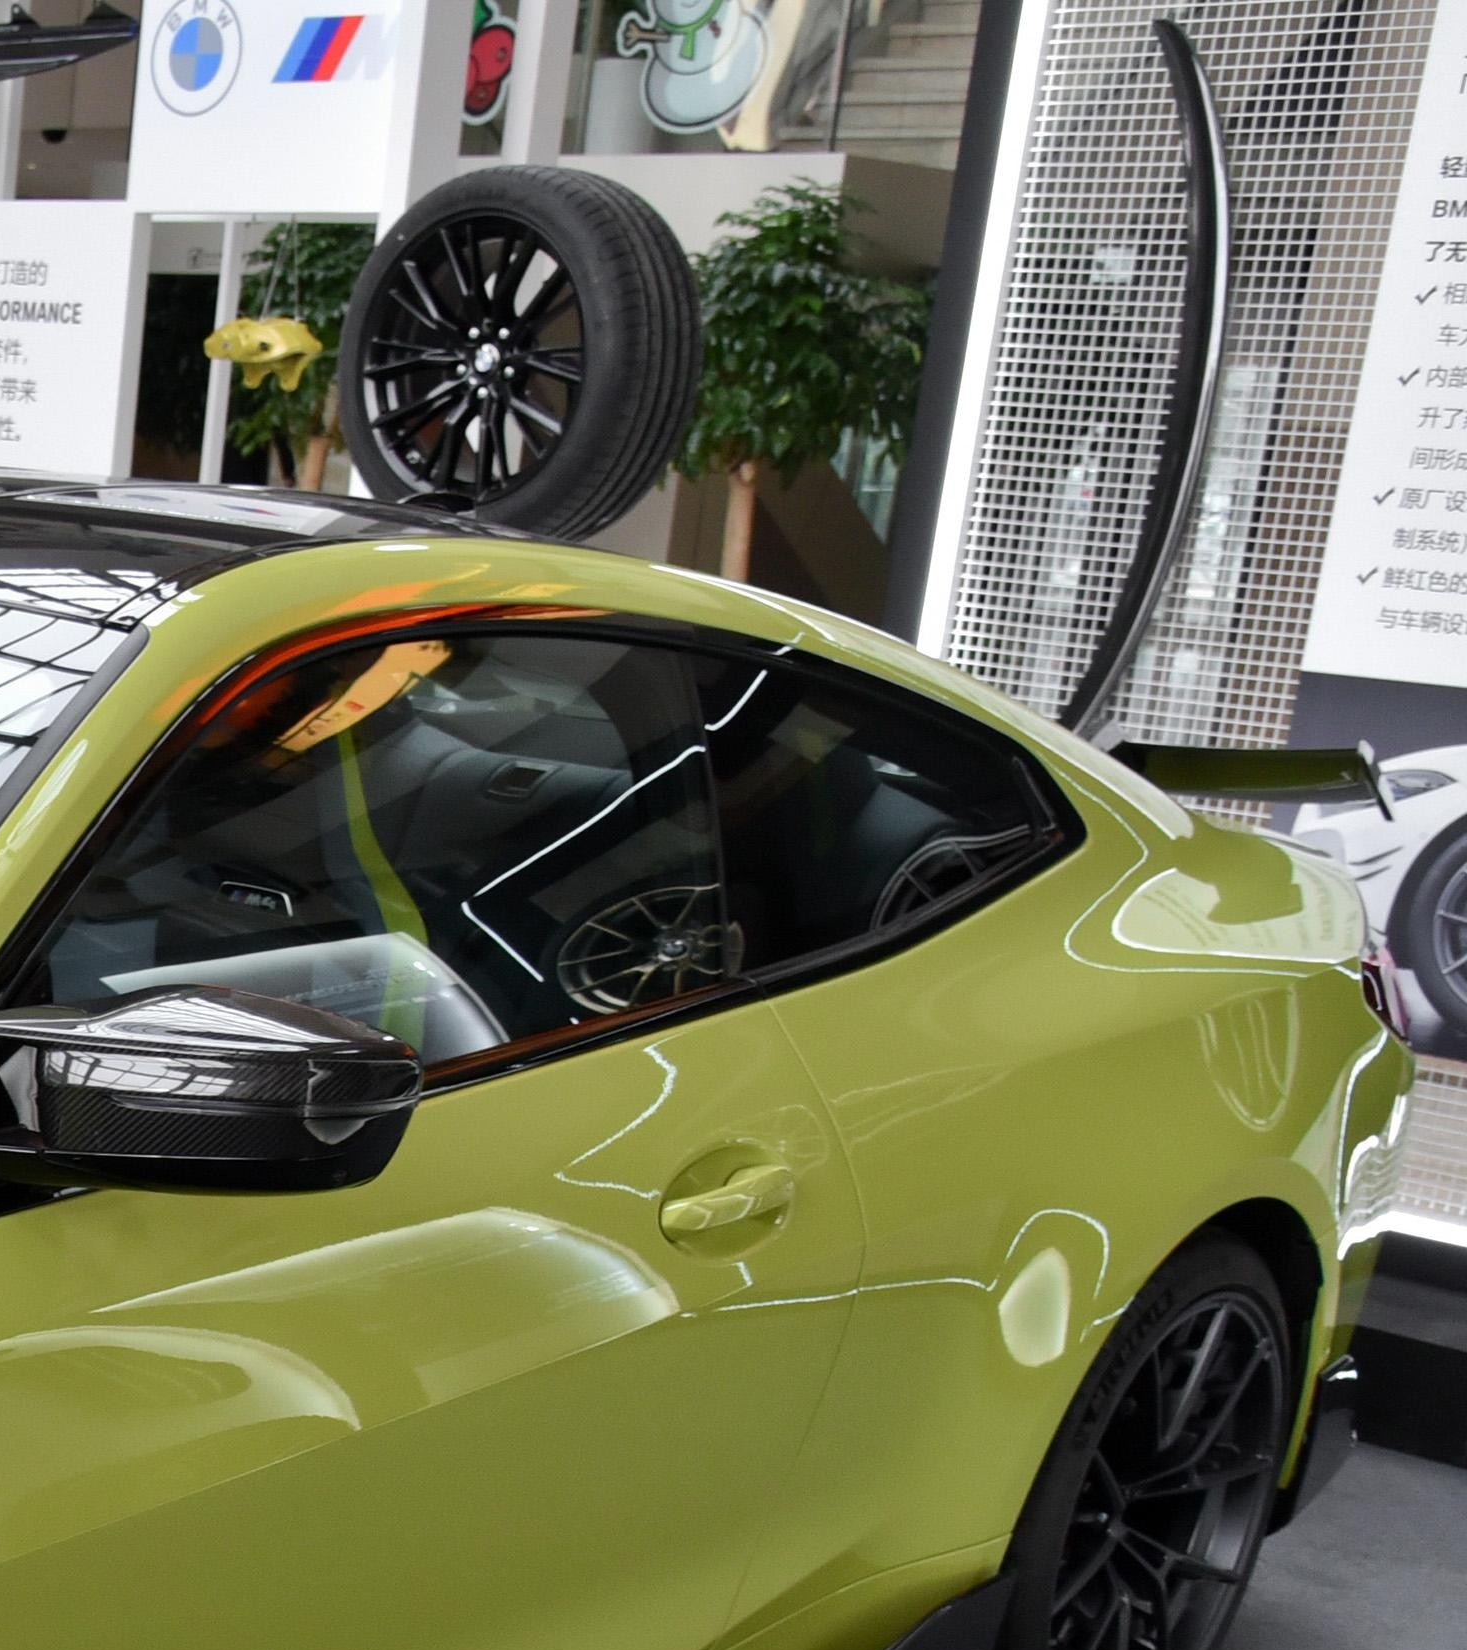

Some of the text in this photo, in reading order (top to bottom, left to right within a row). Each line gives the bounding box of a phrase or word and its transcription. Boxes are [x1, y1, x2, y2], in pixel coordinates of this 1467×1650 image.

[1393, 528, 1467, 554] 制系统
[1376, 606, 1467, 635] 与车辆设
